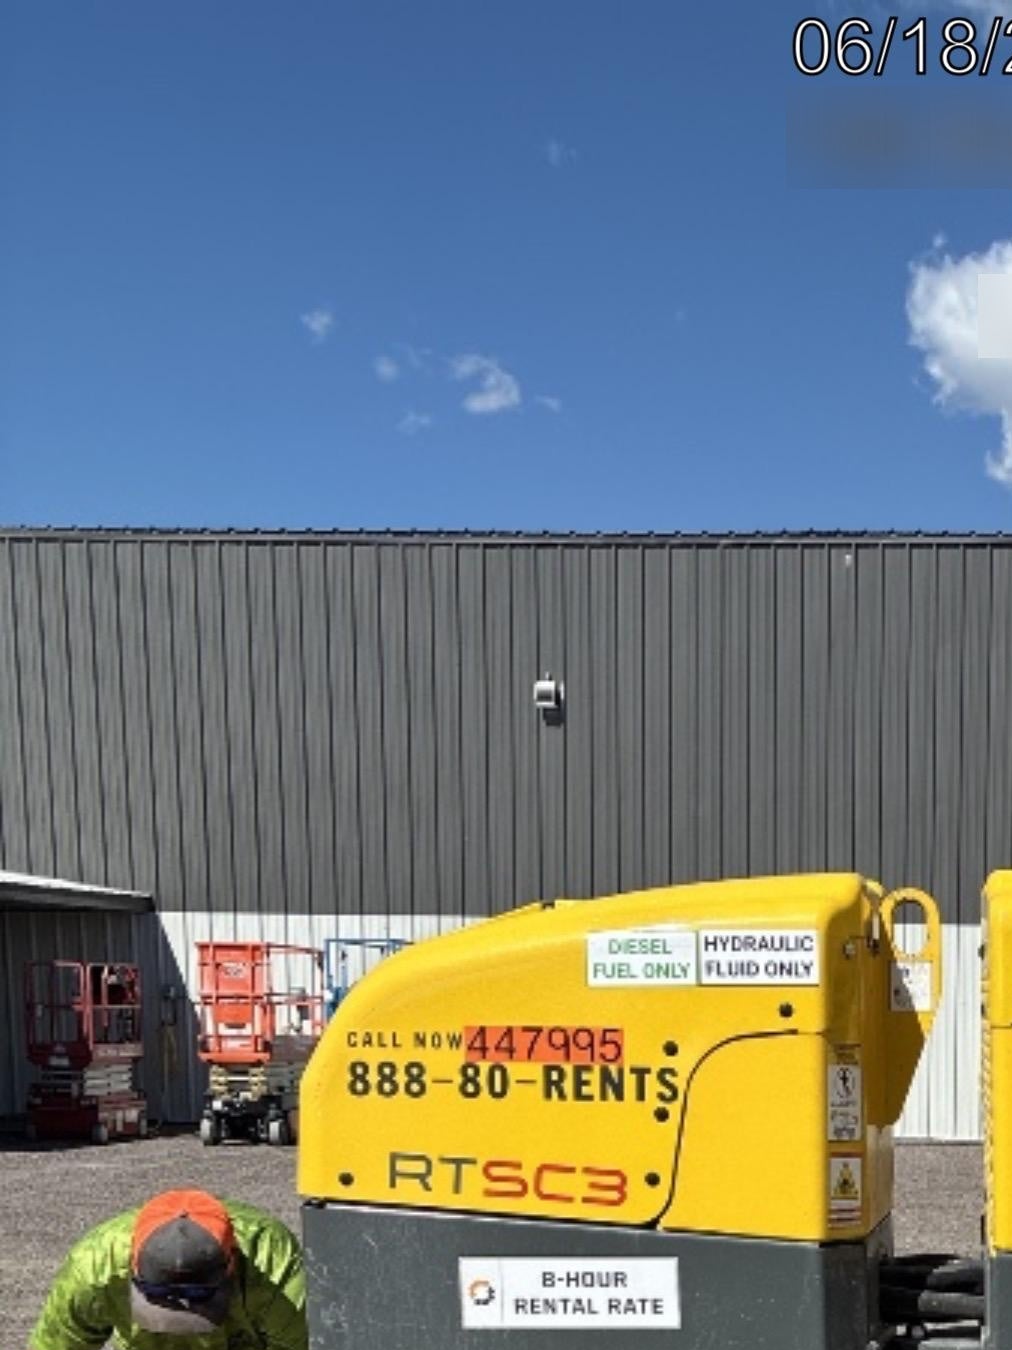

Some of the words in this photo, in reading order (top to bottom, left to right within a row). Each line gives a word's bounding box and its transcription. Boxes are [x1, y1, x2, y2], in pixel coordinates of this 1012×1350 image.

[607, 938, 672, 955] DIESEL
[704, 935, 814, 952] HYDRAULIC
[593, 962, 638, 979] FUEL
[643, 962, 691, 979] ONLY
[705, 960, 760, 977] FLUID
[764, 960, 814, 977] ONLY
[347, 1031, 402, 1048] CALL
[414, 1031, 463, 1049] NOW
[467, 1026, 622, 1062] 447995
[348, 1061, 679, 1102] 888-80-RENTS
[515, 1298, 598, 1315] RENTAL
[608, 1298, 664, 1315] RATE
